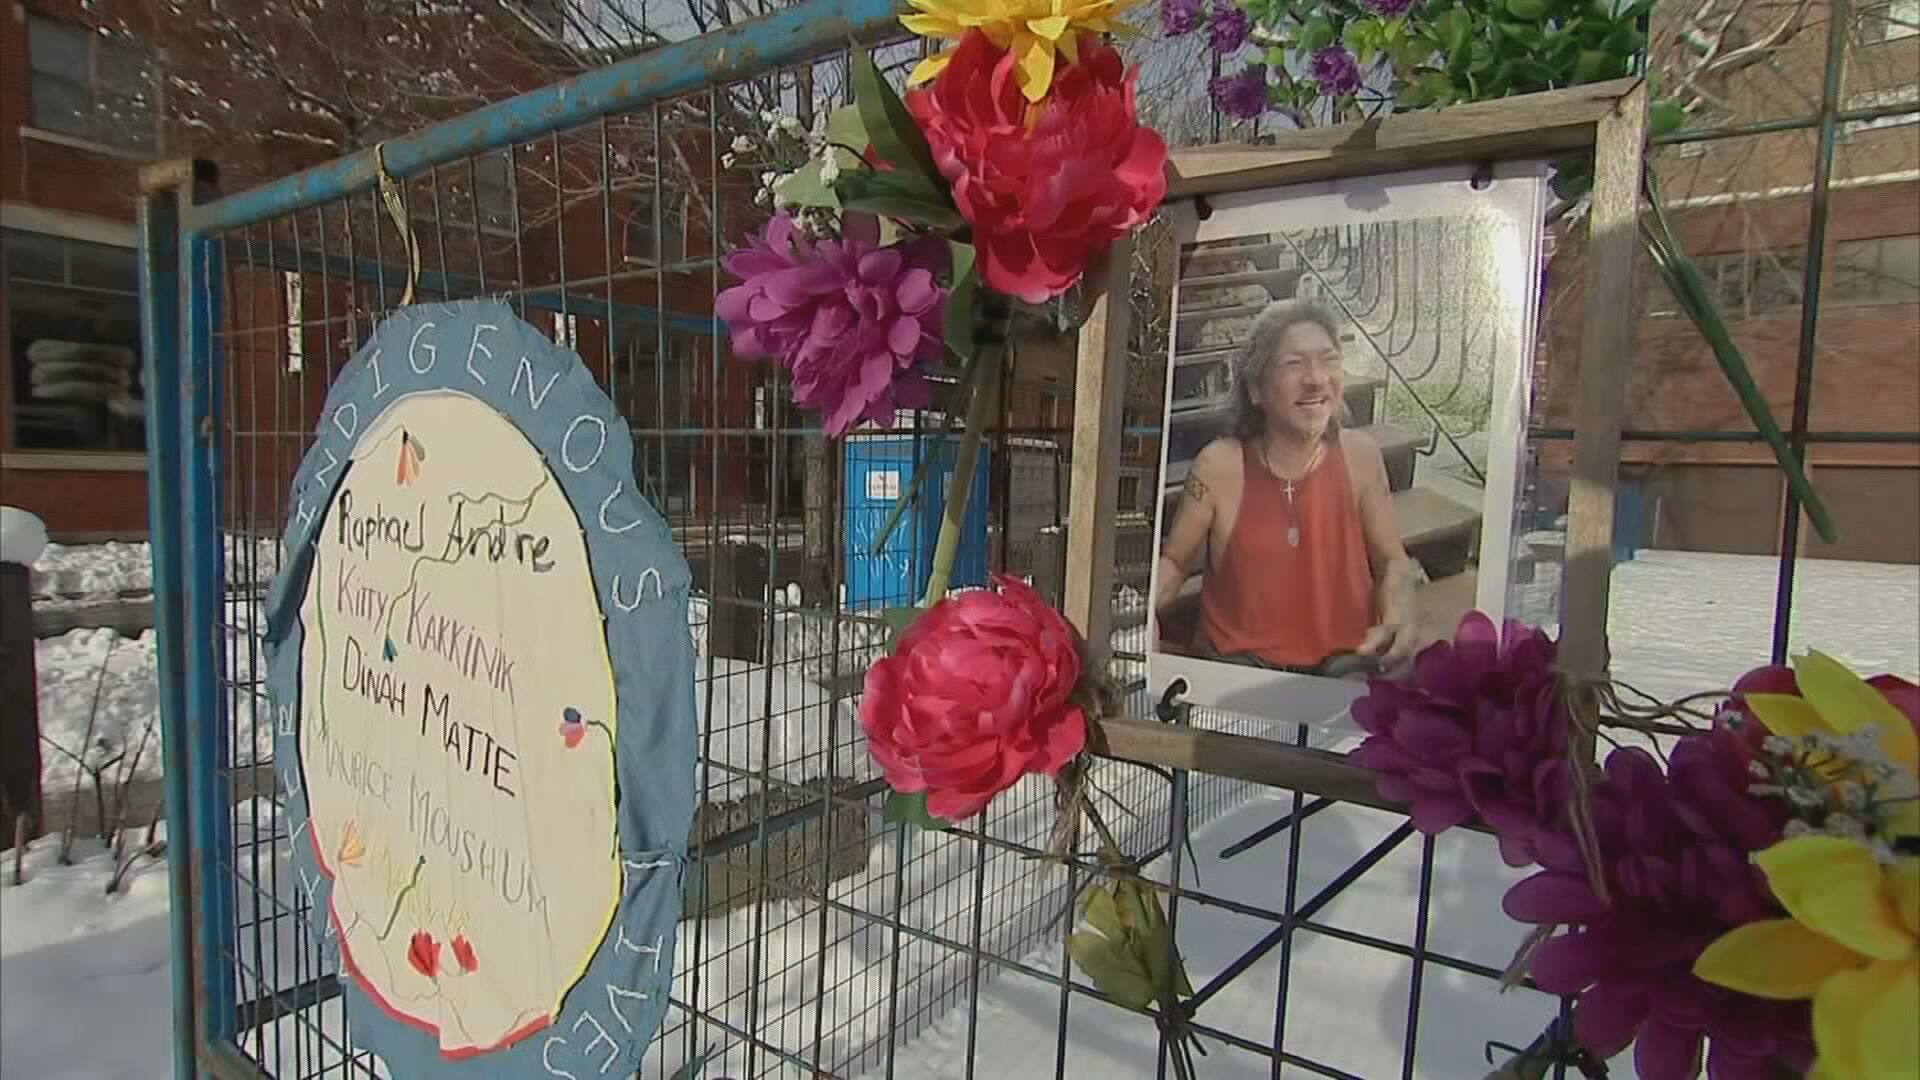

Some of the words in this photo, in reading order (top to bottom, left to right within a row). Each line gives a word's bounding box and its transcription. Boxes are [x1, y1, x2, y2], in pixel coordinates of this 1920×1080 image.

[294, 320, 664, 614] INDIGENOUS
[422, 683, 517, 798] MATTE
[543, 858, 673, 1080] LIVES
